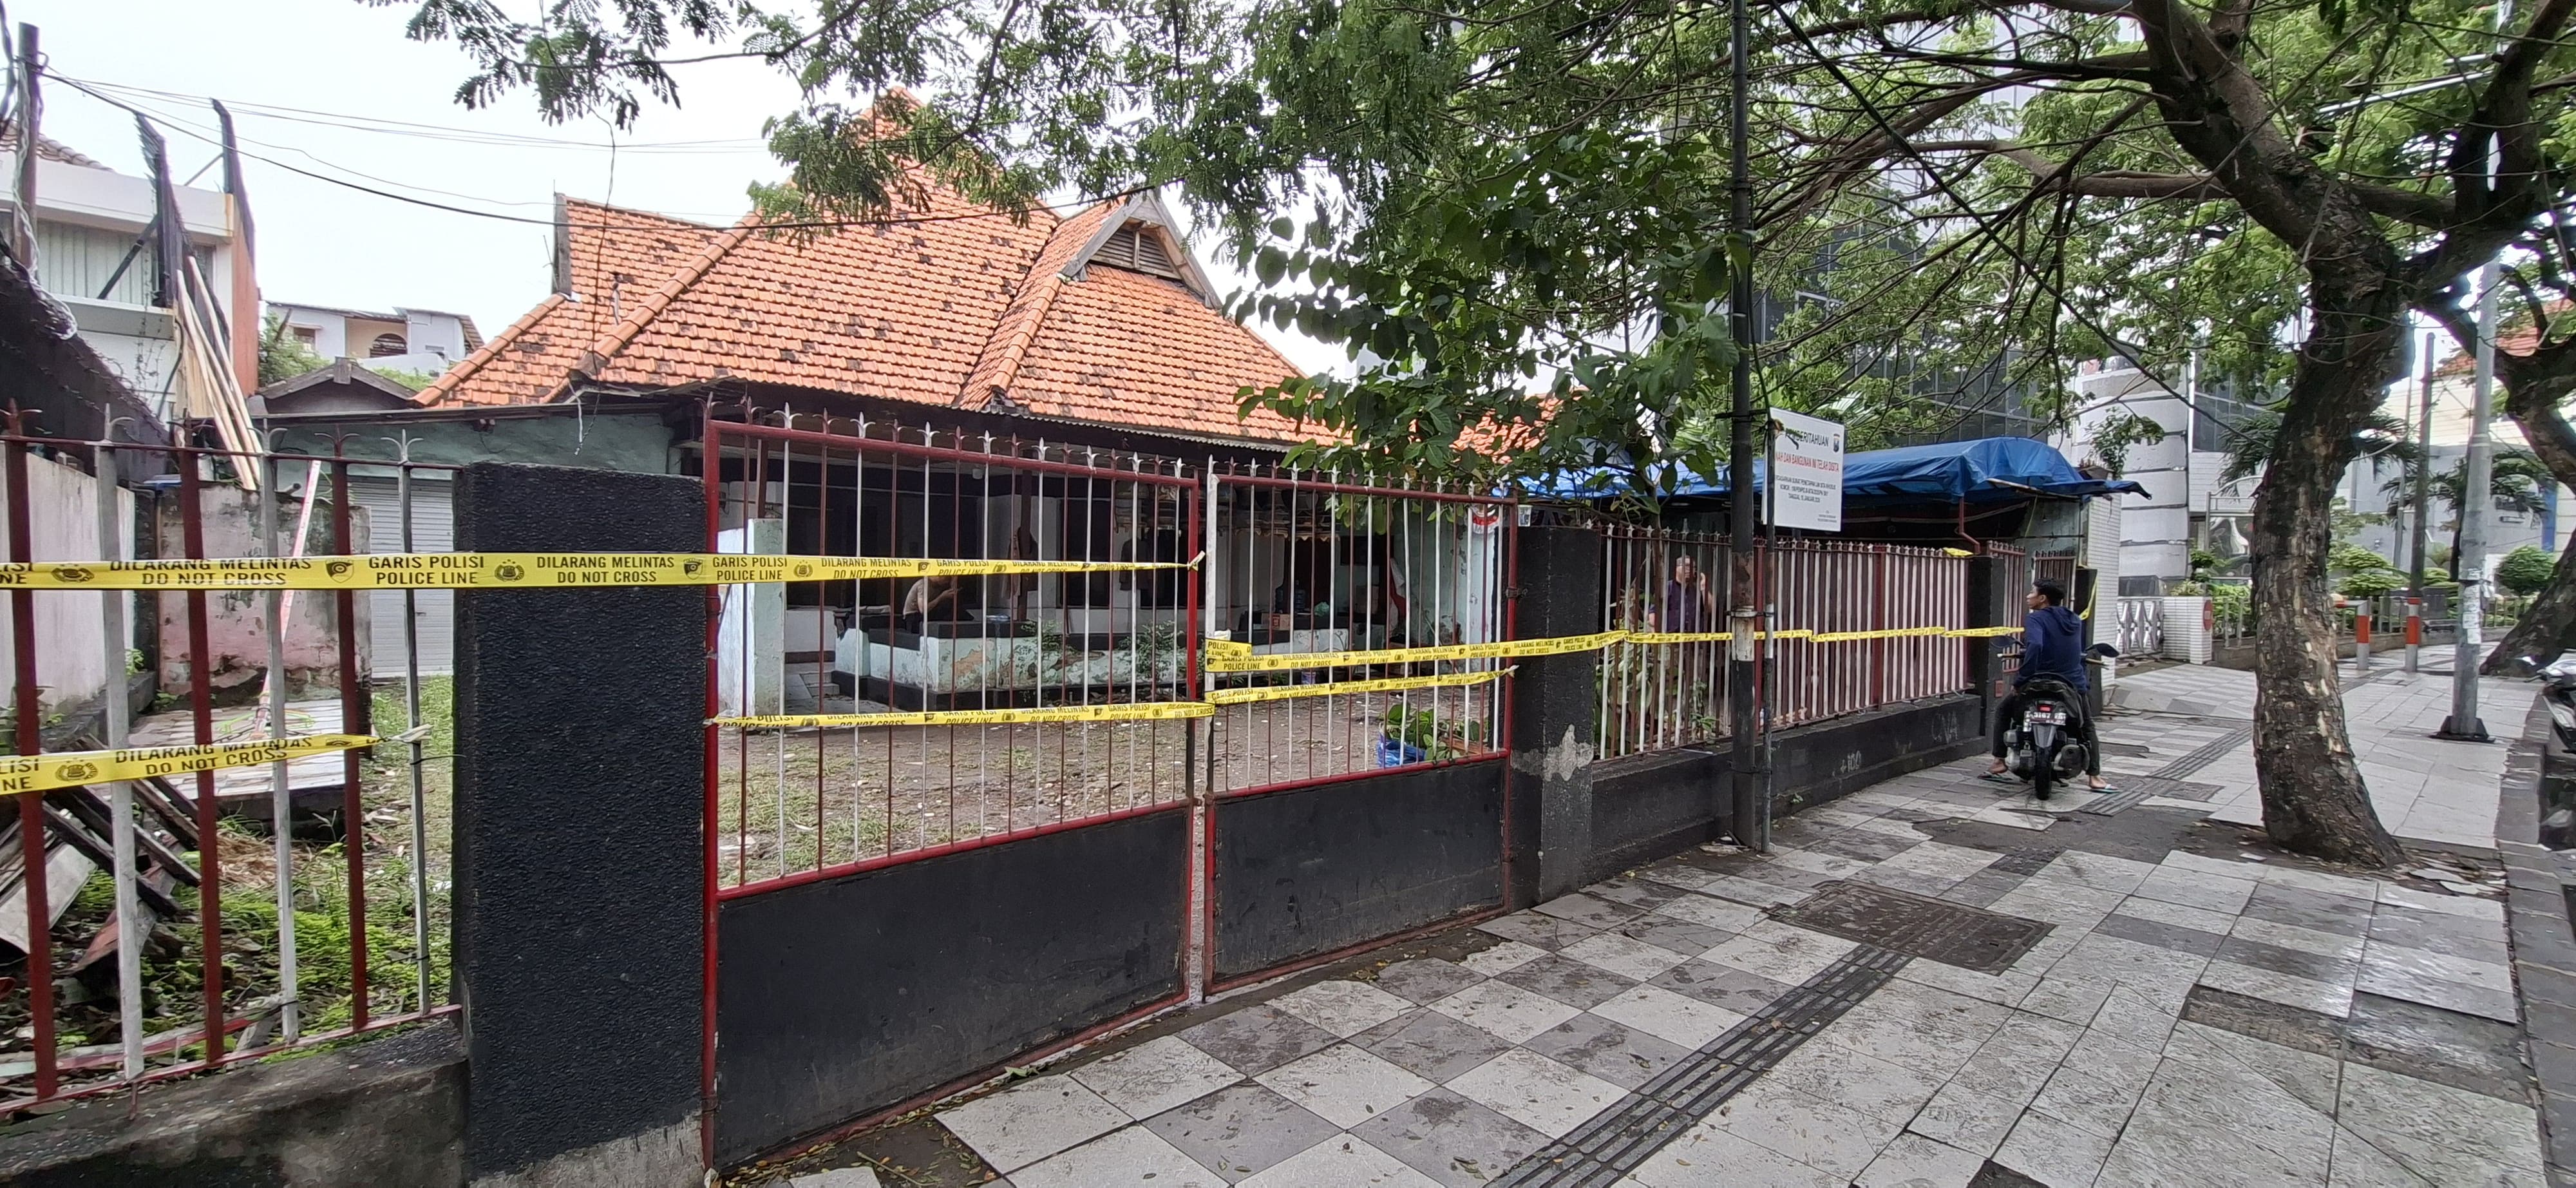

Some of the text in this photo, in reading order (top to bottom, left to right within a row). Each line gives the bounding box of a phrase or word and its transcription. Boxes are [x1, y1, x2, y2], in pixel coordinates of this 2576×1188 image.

[110, 558, 311, 571] DILARANG MELINTAS
[369, 556, 484, 568] GARIS POLISI
[537, 556, 674, 568] DILARANG MELINTAS
[713, 557, 788, 568] GARIS POLISI
[821, 558, 911, 567] DILARANG MELINTAS
[142, 572, 287, 585] DO NOT CROSS
[377, 571, 478, 584] POLICE LINE
[558, 571, 656, 583] DO NOT CROSS
[717, 570, 782, 581] POLICE LINE
[834, 569, 898, 579] DO NOT CROSS
[1208, 641, 1228, 651] POLISI
[1211, 691, 1231, 700] GARIS
[116, 745, 214, 763] DILARANG
[146, 748, 287, 775] DO NOT CROSS
